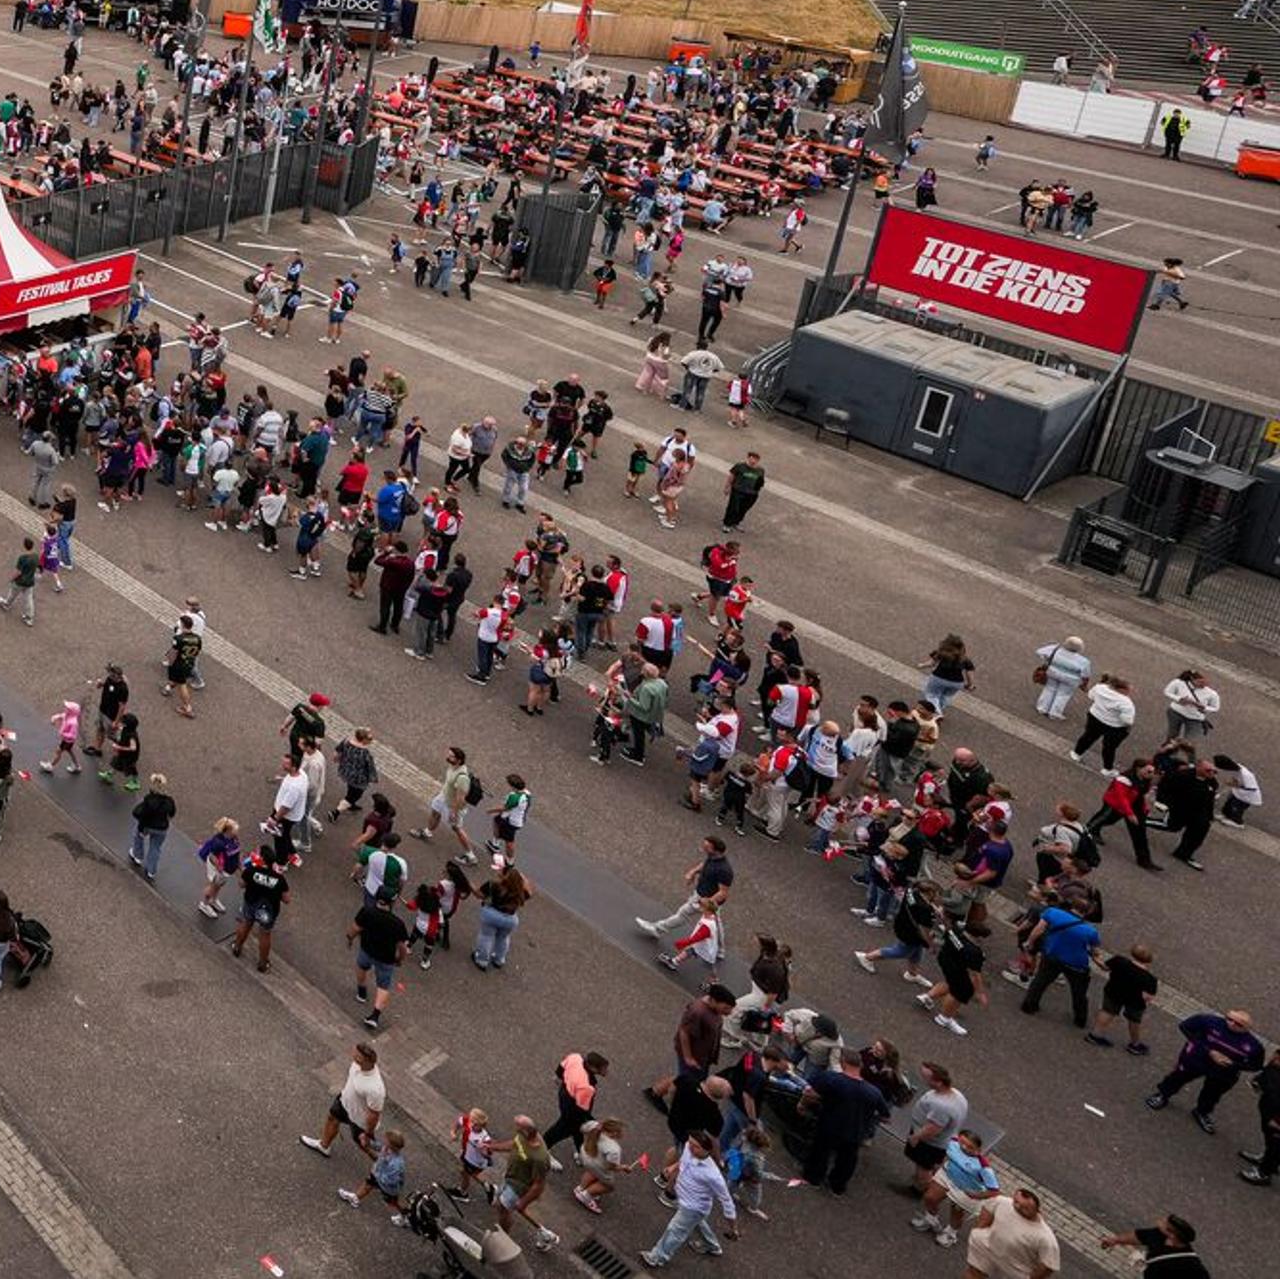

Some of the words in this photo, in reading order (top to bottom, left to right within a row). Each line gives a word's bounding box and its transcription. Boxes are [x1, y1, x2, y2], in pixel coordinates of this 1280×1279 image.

[16, 280, 72, 303] FESTIVAL
[72, 268, 113, 292] TASJES
[911, 256, 951, 284] IN
[948, 265, 997, 294] DE
[995, 280, 1086, 315] KUIP
[922, 237, 987, 267] TOT
[981, 254, 1092, 298] ZIENS
